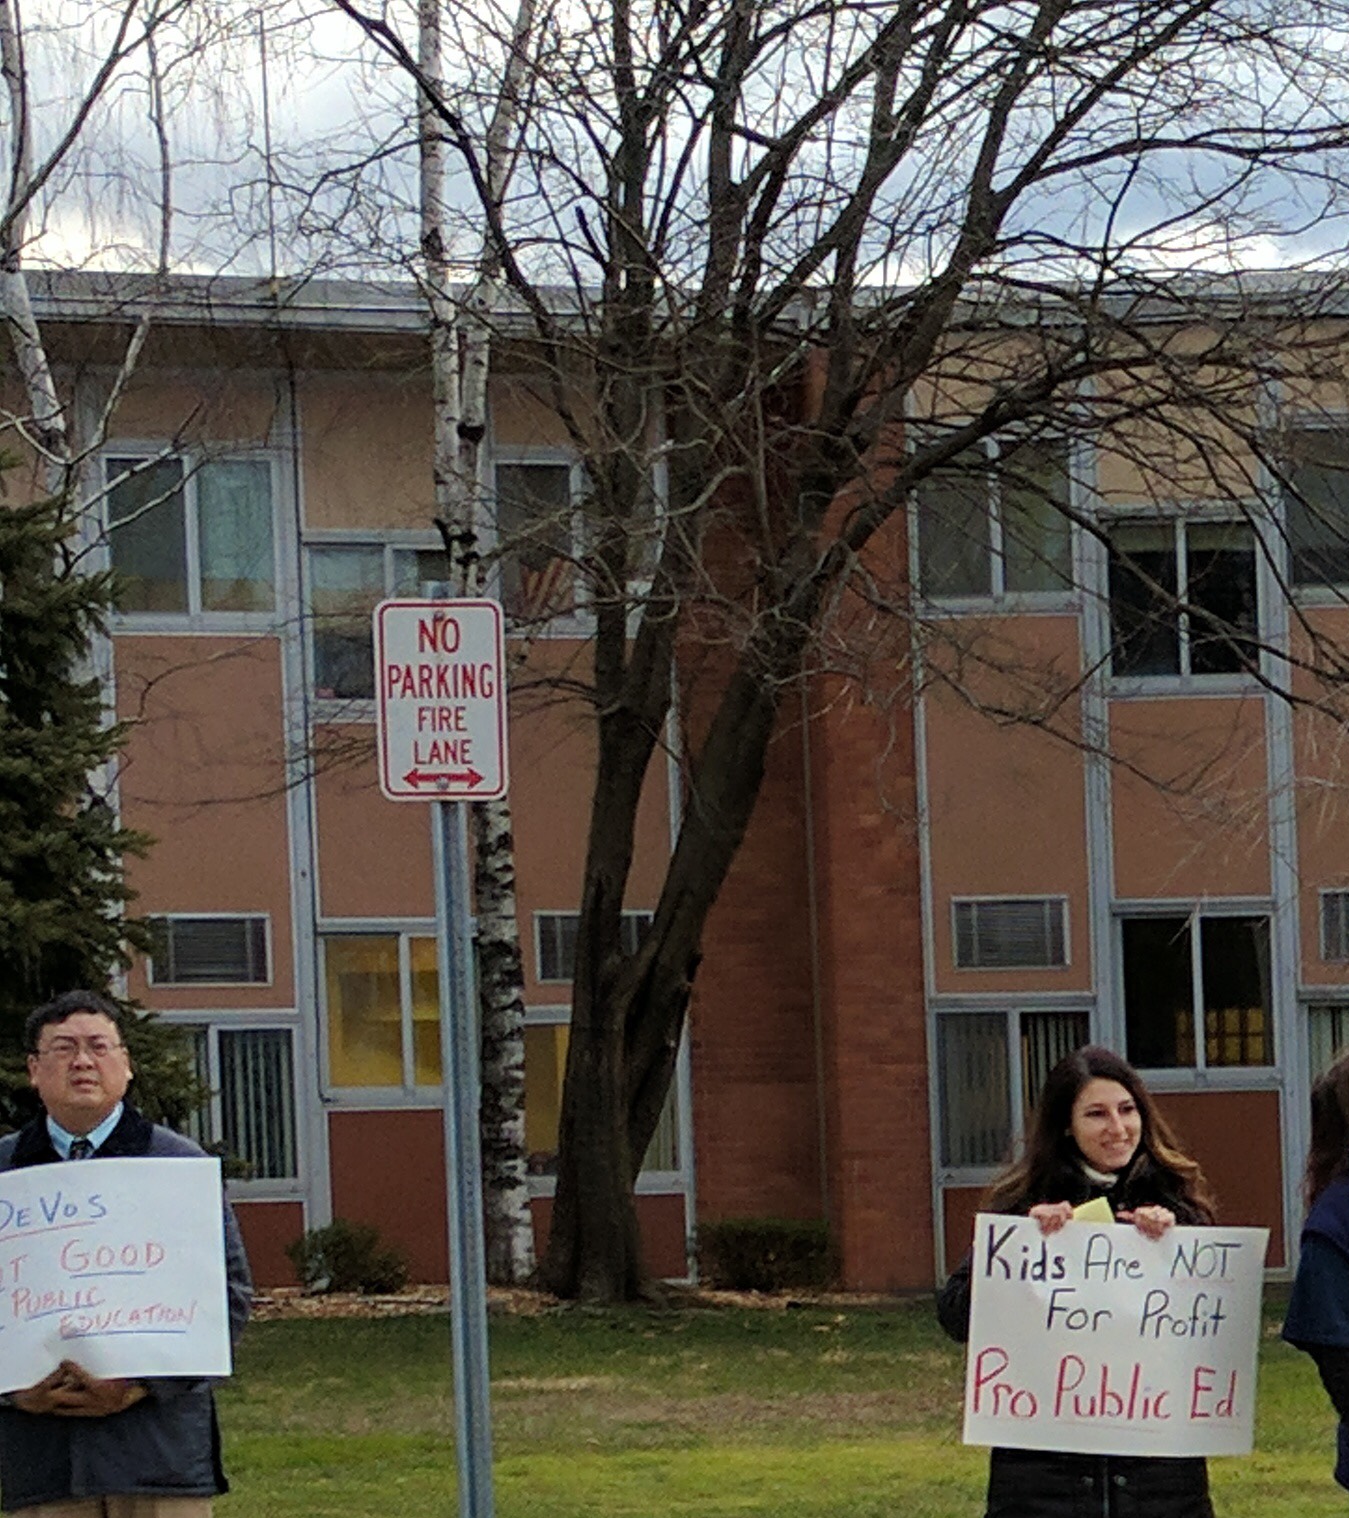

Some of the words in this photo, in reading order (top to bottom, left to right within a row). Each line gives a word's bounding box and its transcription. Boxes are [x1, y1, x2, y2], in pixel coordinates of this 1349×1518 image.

[418, 618, 461, 653] NO
[387, 663, 494, 699] PARKING
[417, 706, 468, 732] FIRE
[413, 739, 474, 765] LANE
[60, 1238, 166, 1273] GOOD
[985, 1223, 1067, 1282] Kids
[1084, 1233, 1144, 1282] Are
[1170, 1238, 1242, 1279] NOT
[11, 1286, 106, 1319] PUBLIC
[1046, 1287, 1112, 1332] For
[1139, 1289, 1227, 1339] Profit
[973, 1347, 1038, 1418] Pro
[1053, 1354, 1171, 1420] Public
